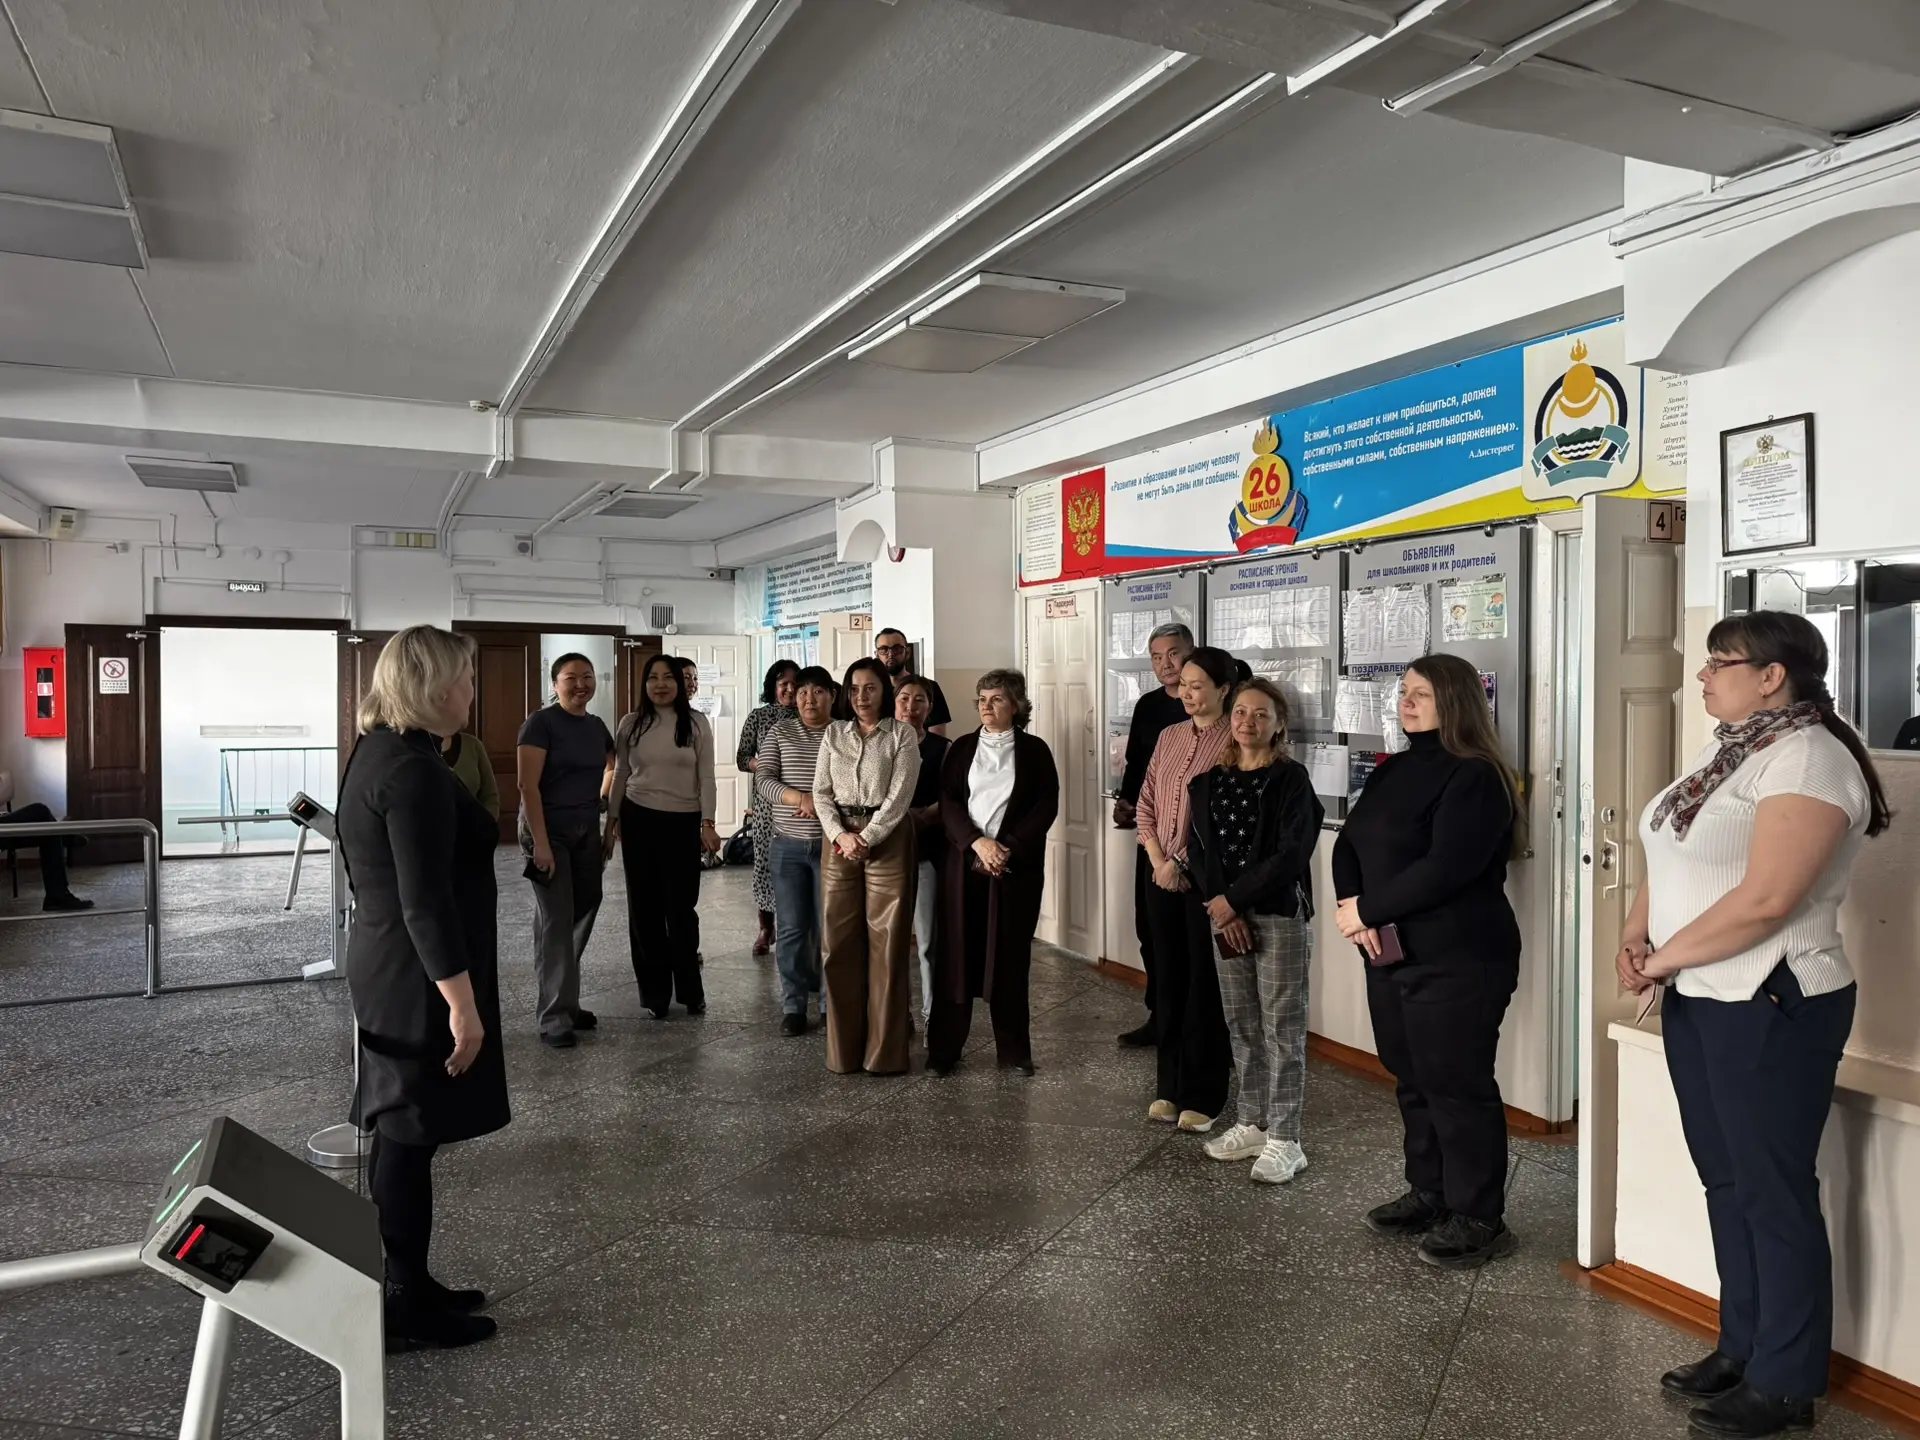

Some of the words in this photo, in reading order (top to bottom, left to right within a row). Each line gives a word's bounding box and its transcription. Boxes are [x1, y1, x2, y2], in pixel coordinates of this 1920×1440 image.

[1304, 429, 1331, 443] Всякий,
[1333, 426, 1345, 436] кто
[1346, 416, 1374, 433] желает
[1375, 416, 1381, 425] к
[1382, 412, 1399, 424] ним
[1400, 395, 1459, 419] приобщиться,
[1461, 385, 1497, 406] должен
[1303, 443, 1342, 461] достигнуть
[1343, 437, 1364, 450] этого
[1365, 422, 1414, 445] собственной
[1416, 408, 1484, 435] деятельностью,
[1303, 457, 1355, 476] собственными
[1355, 451, 1387, 466] силами,
[1388, 436, 1444, 458] собственным
[1445, 422, 1520, 445] напряжением».
[1468, 443, 1516, 459] А.Дистервег
[1743, 450, 1790, 468] ДИПЛОМ
[1110, 477, 1137, 492] «Развитие
[1143, 467, 1178, 485] образование
[1178, 466, 1186, 475] ни
[1187, 460, 1210, 475] одному
[1211, 451, 1241, 467] человеку
[1136, 492, 1144, 501] не
[1144, 487, 1160, 500] могут
[1161, 485, 1175, 497] быть
[1175, 481, 1192, 494] даны
[1192, 478, 1204, 489] или
[1205, 469, 1240, 486] сообщены.
[1249, 463, 1281, 500] 26
[1249, 497, 1281, 513] ШКОЛА
[1655, 511, 1666, 532] 4
[1403, 543, 1455, 562] ОБЪЯВЛЕНИЯ
[1238, 564, 1274, 580] РАСПИСАНИЕ
[1275, 562, 1299, 577] УРОКОВ
[1367, 568, 1381, 580] для
[1382, 561, 1430, 577] школьников
[1431, 562, 1438, 571] и
[1439, 561, 1449, 571] их
[1451, 552, 1497, 572] родителей
[229, 582, 260, 593] ВЫХОД
[1229, 580, 1256, 592] основная
[1261, 576, 1287, 591] старшая
[1287, 574, 1308, 586] школа
[1047, 603, 1053, 614] 3
[853, 617, 861, 627] 2
[1481, 621, 1495, 630] 124
[1352, 663, 1406, 674] ПОЗДРАВЛЕН
